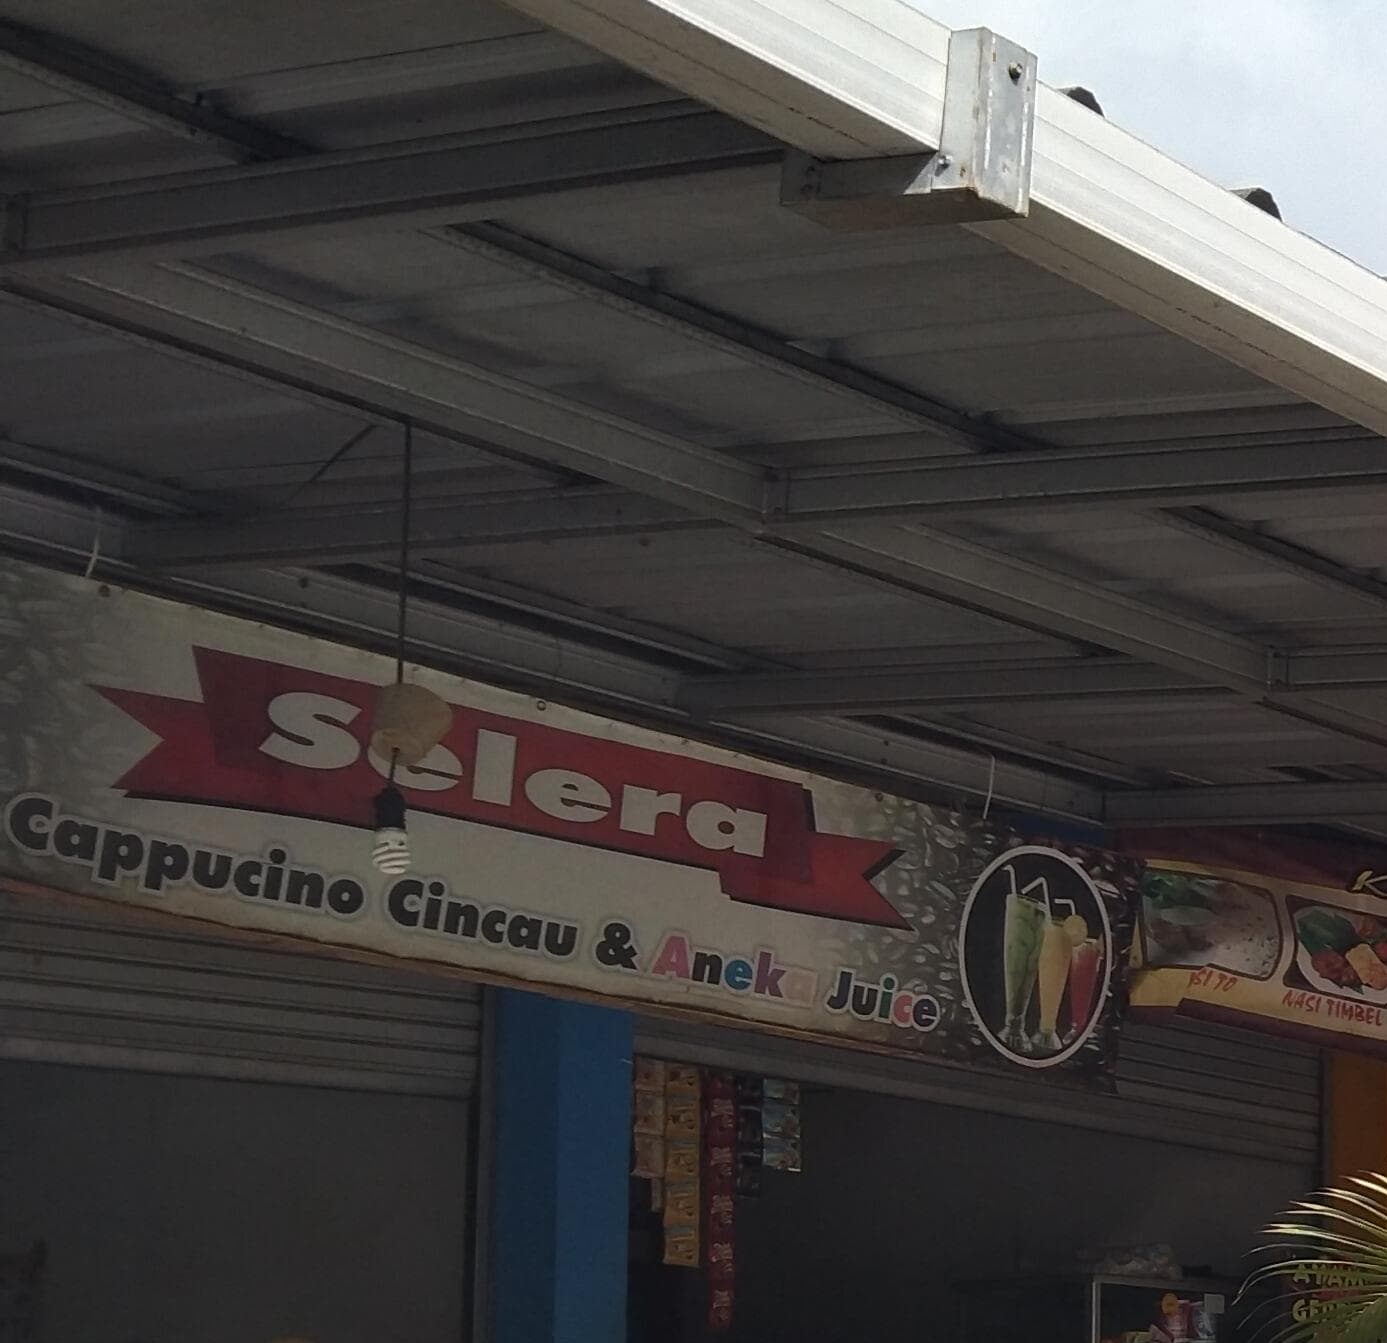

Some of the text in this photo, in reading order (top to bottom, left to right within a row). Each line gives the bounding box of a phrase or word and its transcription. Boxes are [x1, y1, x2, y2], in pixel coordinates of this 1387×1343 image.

[258, 691, 767, 858] Selera
[9, 799, 939, 1029] Cappucino Cincau & Aneka Juice
[1282, 990, 1383, 1027] NASI TIMBEL
